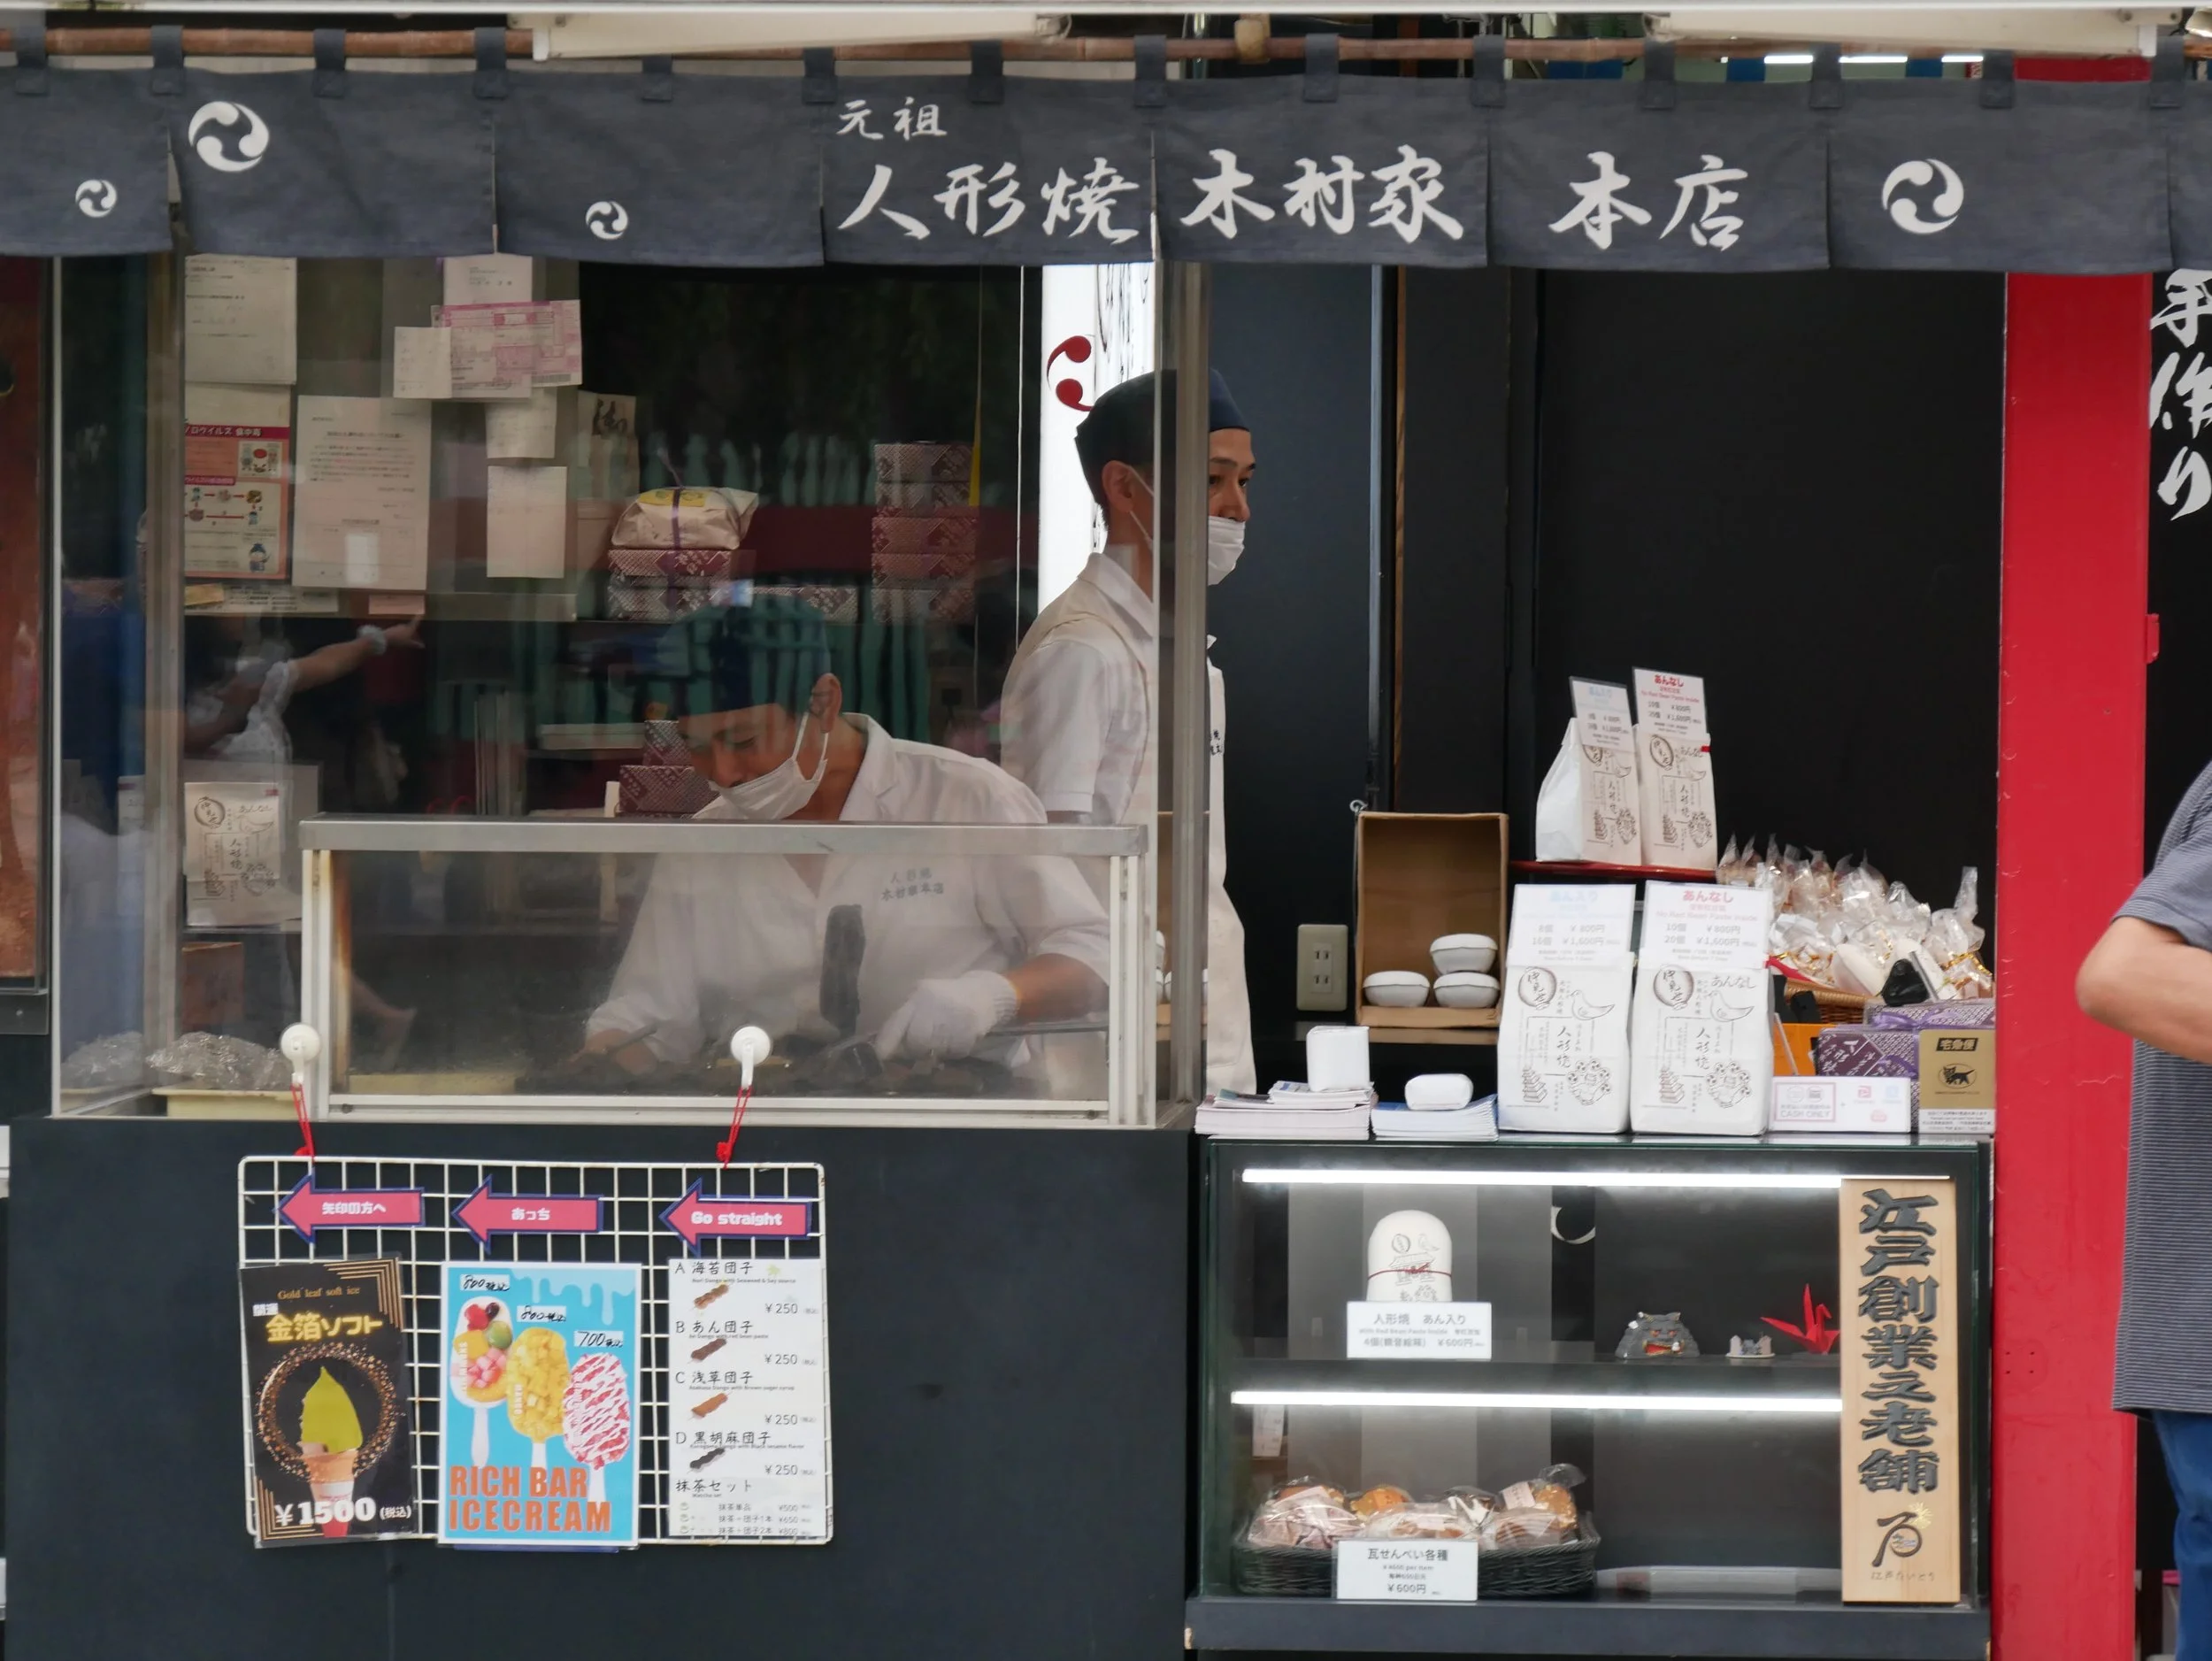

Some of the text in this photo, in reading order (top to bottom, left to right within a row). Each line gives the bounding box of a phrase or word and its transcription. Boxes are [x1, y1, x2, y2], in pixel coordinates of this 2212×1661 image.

[836, 96, 948, 141] 元祖
[838, 143, 1750, 252] 人形焼 木村家 本店
[1682, 890, 1734, 903] あんなし
[1711, 975, 1756, 989] あんなし
[1556, 1026, 1571, 1069] 人形焼
[1695, 1027, 1711, 1070] 人形焼
[1780, 1110, 1805, 1119] CASH
[321, 1202, 387, 1215] 矢印の方へ
[511, 1207, 550, 1221] あっち
[691, 1211, 783, 1227] Go straight
[675, 1262, 754, 1275] A 海苔団子
[277, 1286, 360, 1300] Gold leaf soft ice
[765, 1303, 798, 1314] ¥250
[1373, 1313, 1466, 1325] 人形焼 あん入り
[265, 1311, 383, 1342] 金箔ソフト
[675, 1320, 754, 1334] B あん団子
[1858, 1188, 1939, 1495] 江戸創業之老舗
[764, 1354, 797, 1365] ¥250
[675, 1371, 754, 1384] C 浅草団子
[764, 1414, 798, 1425] ¥250
[675, 1431, 772, 1445] D 黒胡麻団子
[764, 1465, 798, 1475] ¥250
[449, 1465, 588, 1499] RICH BAR
[675, 1479, 752, 1493] 抹茶セット
[274, 1496, 412, 1526] ¥1500 (税込)
[449, 1499, 611, 1532] ICECREAM
[1367, 1548, 1448, 1562] 瓦せんべい各種
[1387, 1583, 1426, 1595] ¥600円
